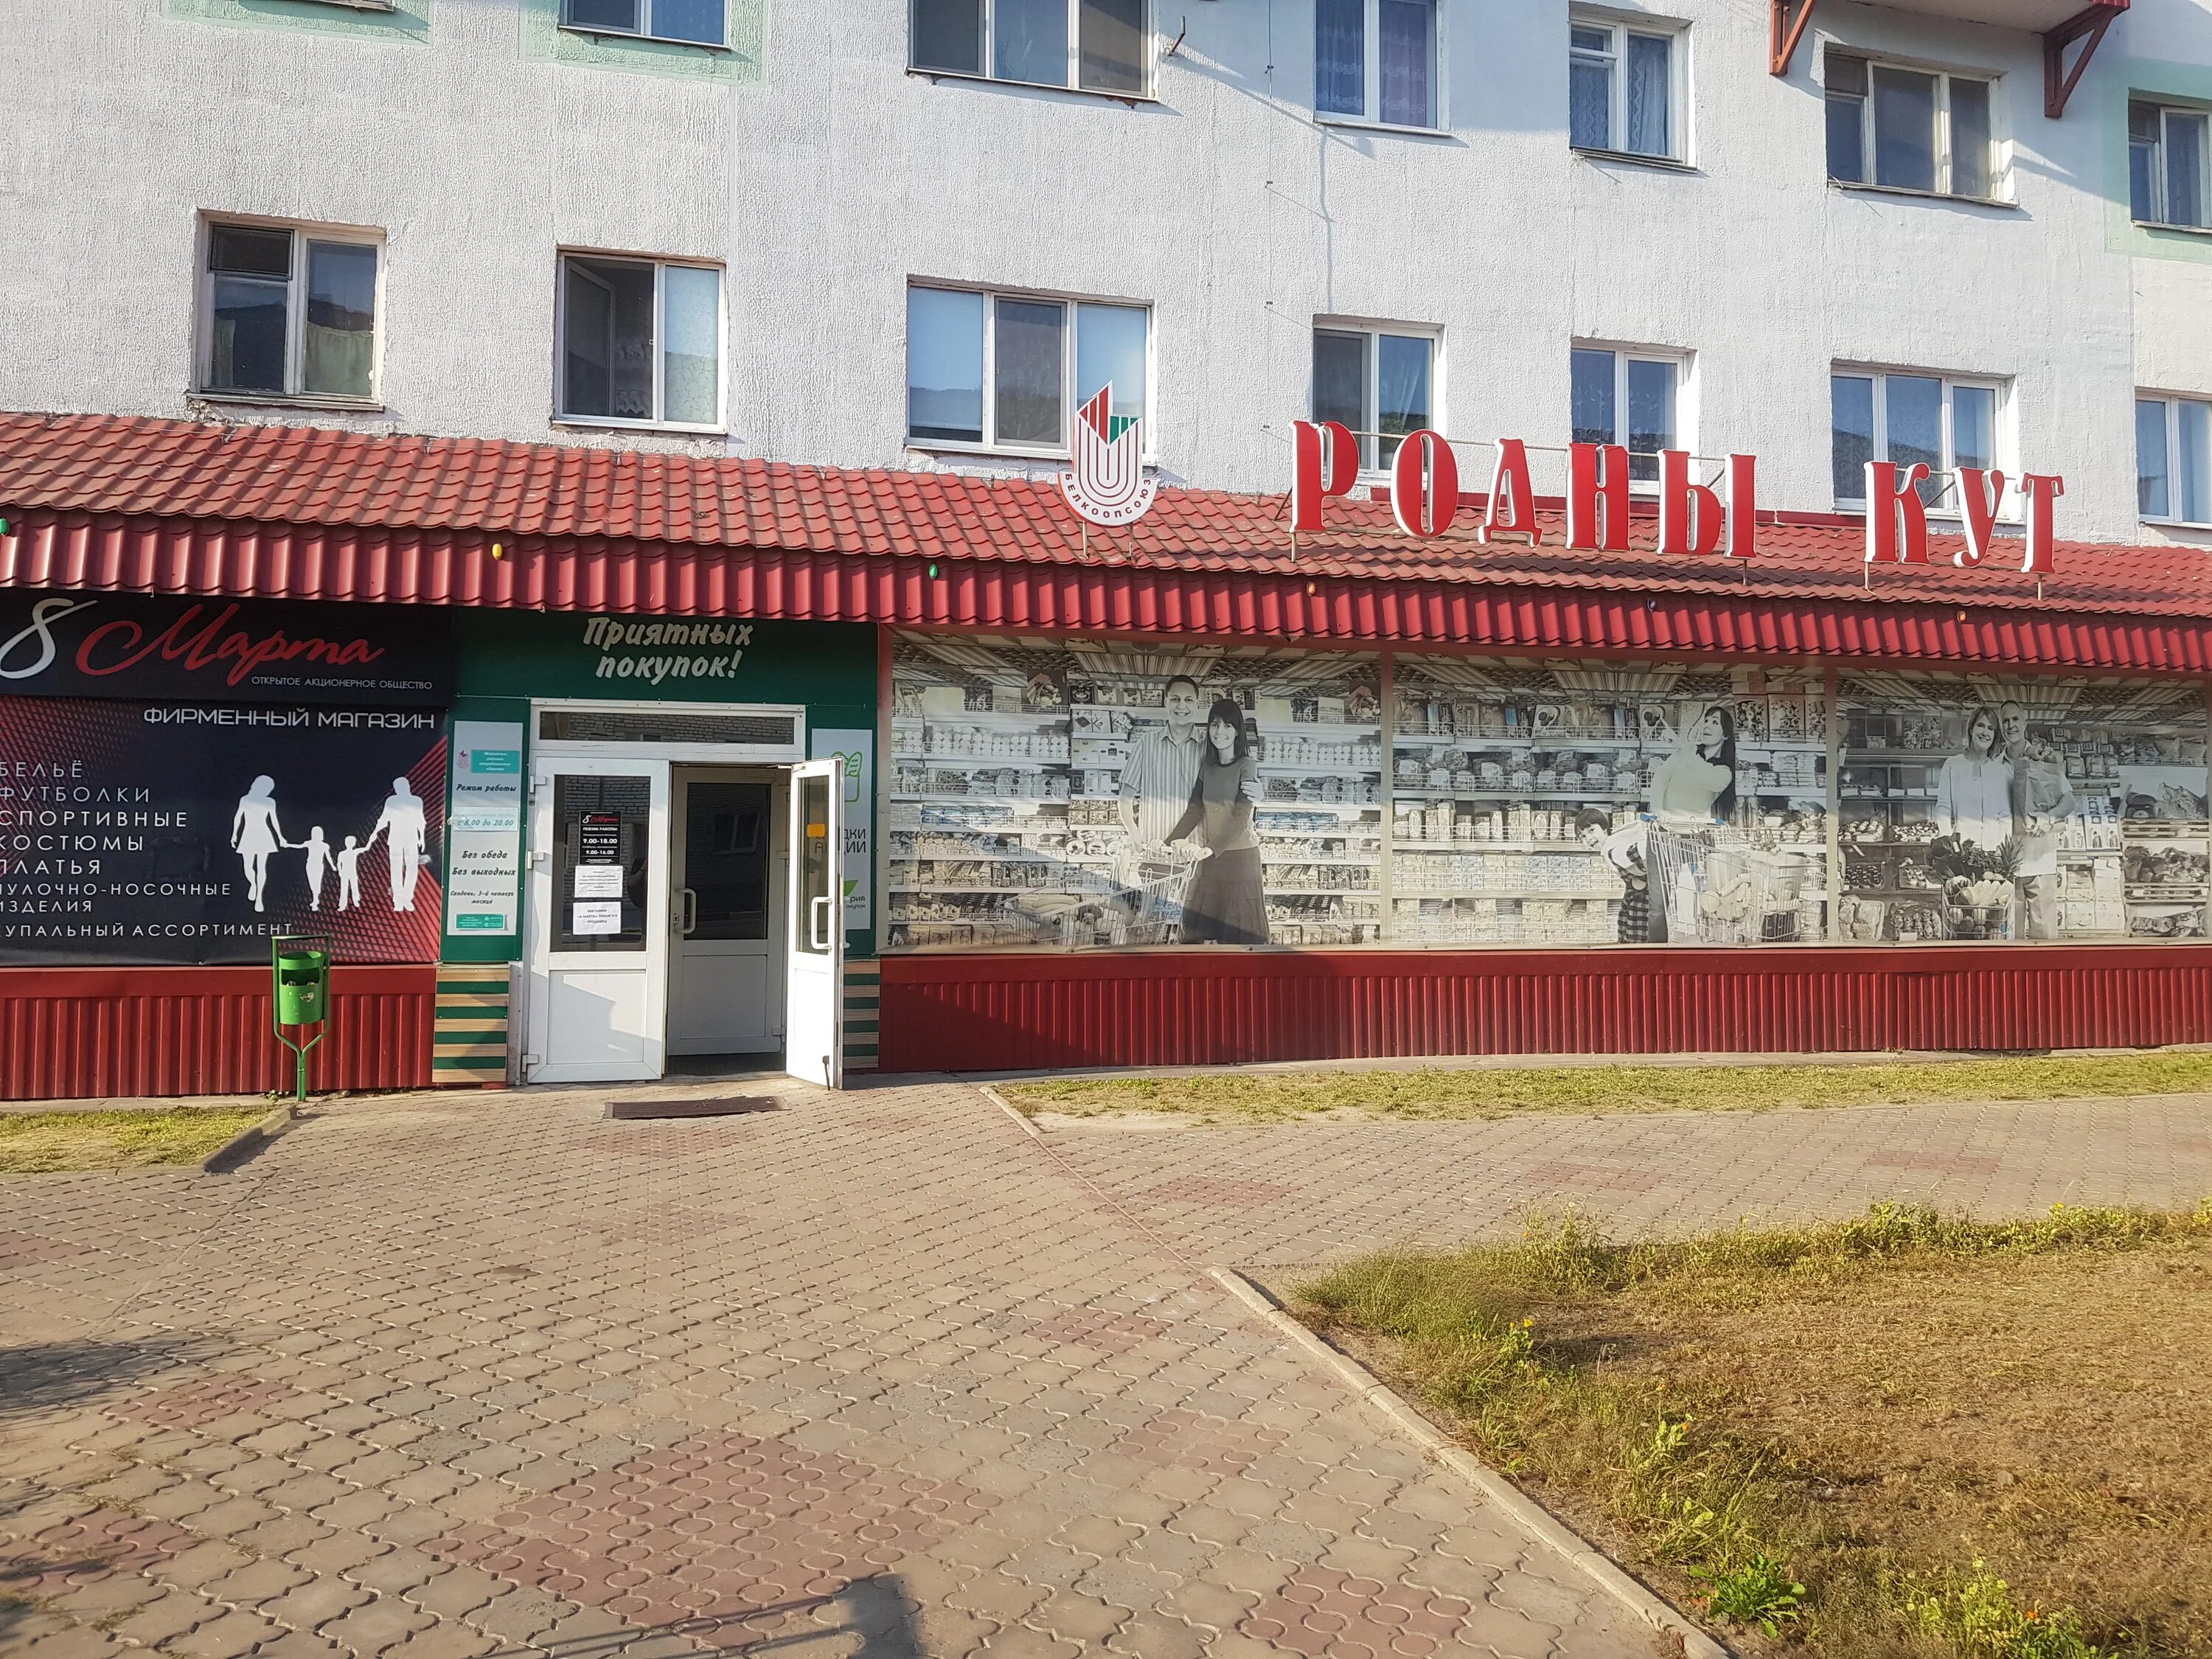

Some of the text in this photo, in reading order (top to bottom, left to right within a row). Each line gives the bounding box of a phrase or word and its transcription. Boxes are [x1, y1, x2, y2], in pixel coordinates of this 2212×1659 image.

[1065, 473, 1151, 518] БЕЛКООПСОЮЗ
[1290, 420, 2065, 574] РОДНЫ КУТ
[0, 598, 385, 686] 8 Марта
[582, 616, 754, 652] Приятных
[595, 649, 743, 686] покупок!
[251, 676, 432, 690] ОТКРЫТОЕ АКЦИОНЕРНОЕ ОБЩЕСТВО
[144, 707, 434, 729] ФИРМЕННЫЙ МАГАЗИН
[0, 760, 83, 778] БЕЛЬЁ
[0, 786, 149, 802] ФУТБОЛКИ
[484, 784, 517, 793] работы
[0, 810, 187, 827] СПОРТИВНЫЕ
[493, 818, 514, 827] 20.00
[582, 815, 592, 824] 8
[462, 849, 507, 859] Без обеда
[452, 866, 516, 876] Без выходных
[0, 883, 230, 896] УЛОЧНО-НОСОЧНЫЕ
[0, 922, 291, 937] УПАЛЬНЫЙ АССОРТИМЕНТ
